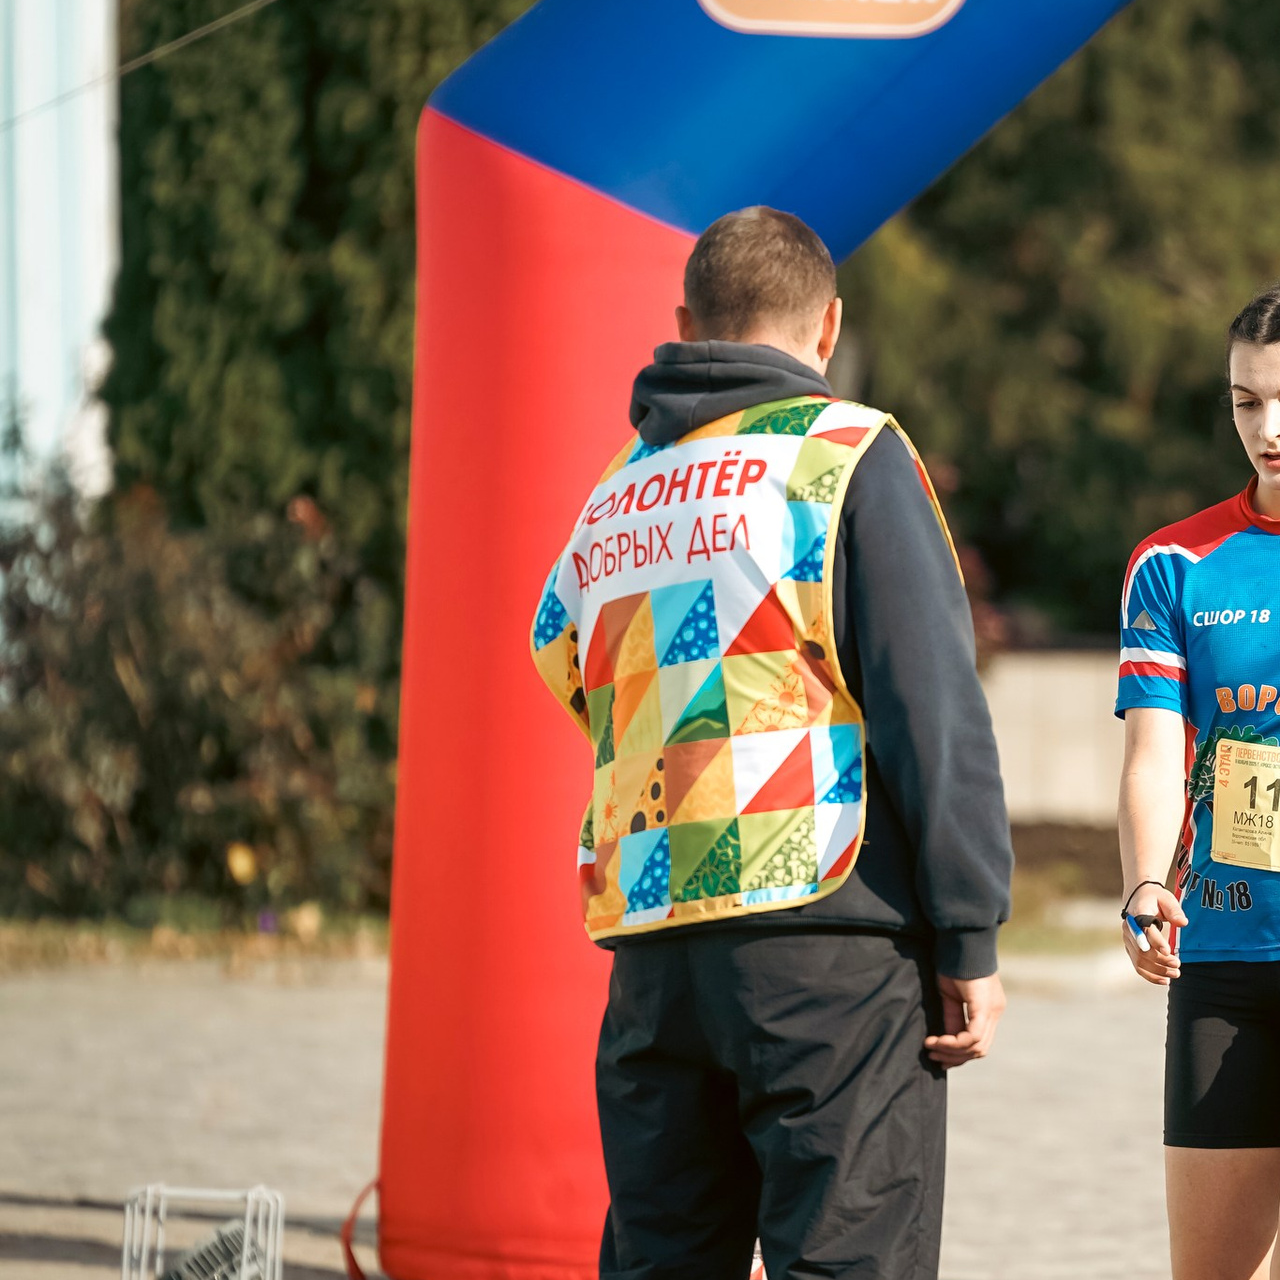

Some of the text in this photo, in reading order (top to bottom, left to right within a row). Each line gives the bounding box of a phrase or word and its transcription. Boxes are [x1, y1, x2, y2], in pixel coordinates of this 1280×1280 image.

[572, 514, 750, 595] ДОБРЫХ ДЕЛ
[1193, 609, 1271, 627] СШОР 18
[1219, 744, 1232, 777] ЭТАП
[1233, 811, 1274, 829] МЖ18
[1226, 880, 1252, 911] 18
